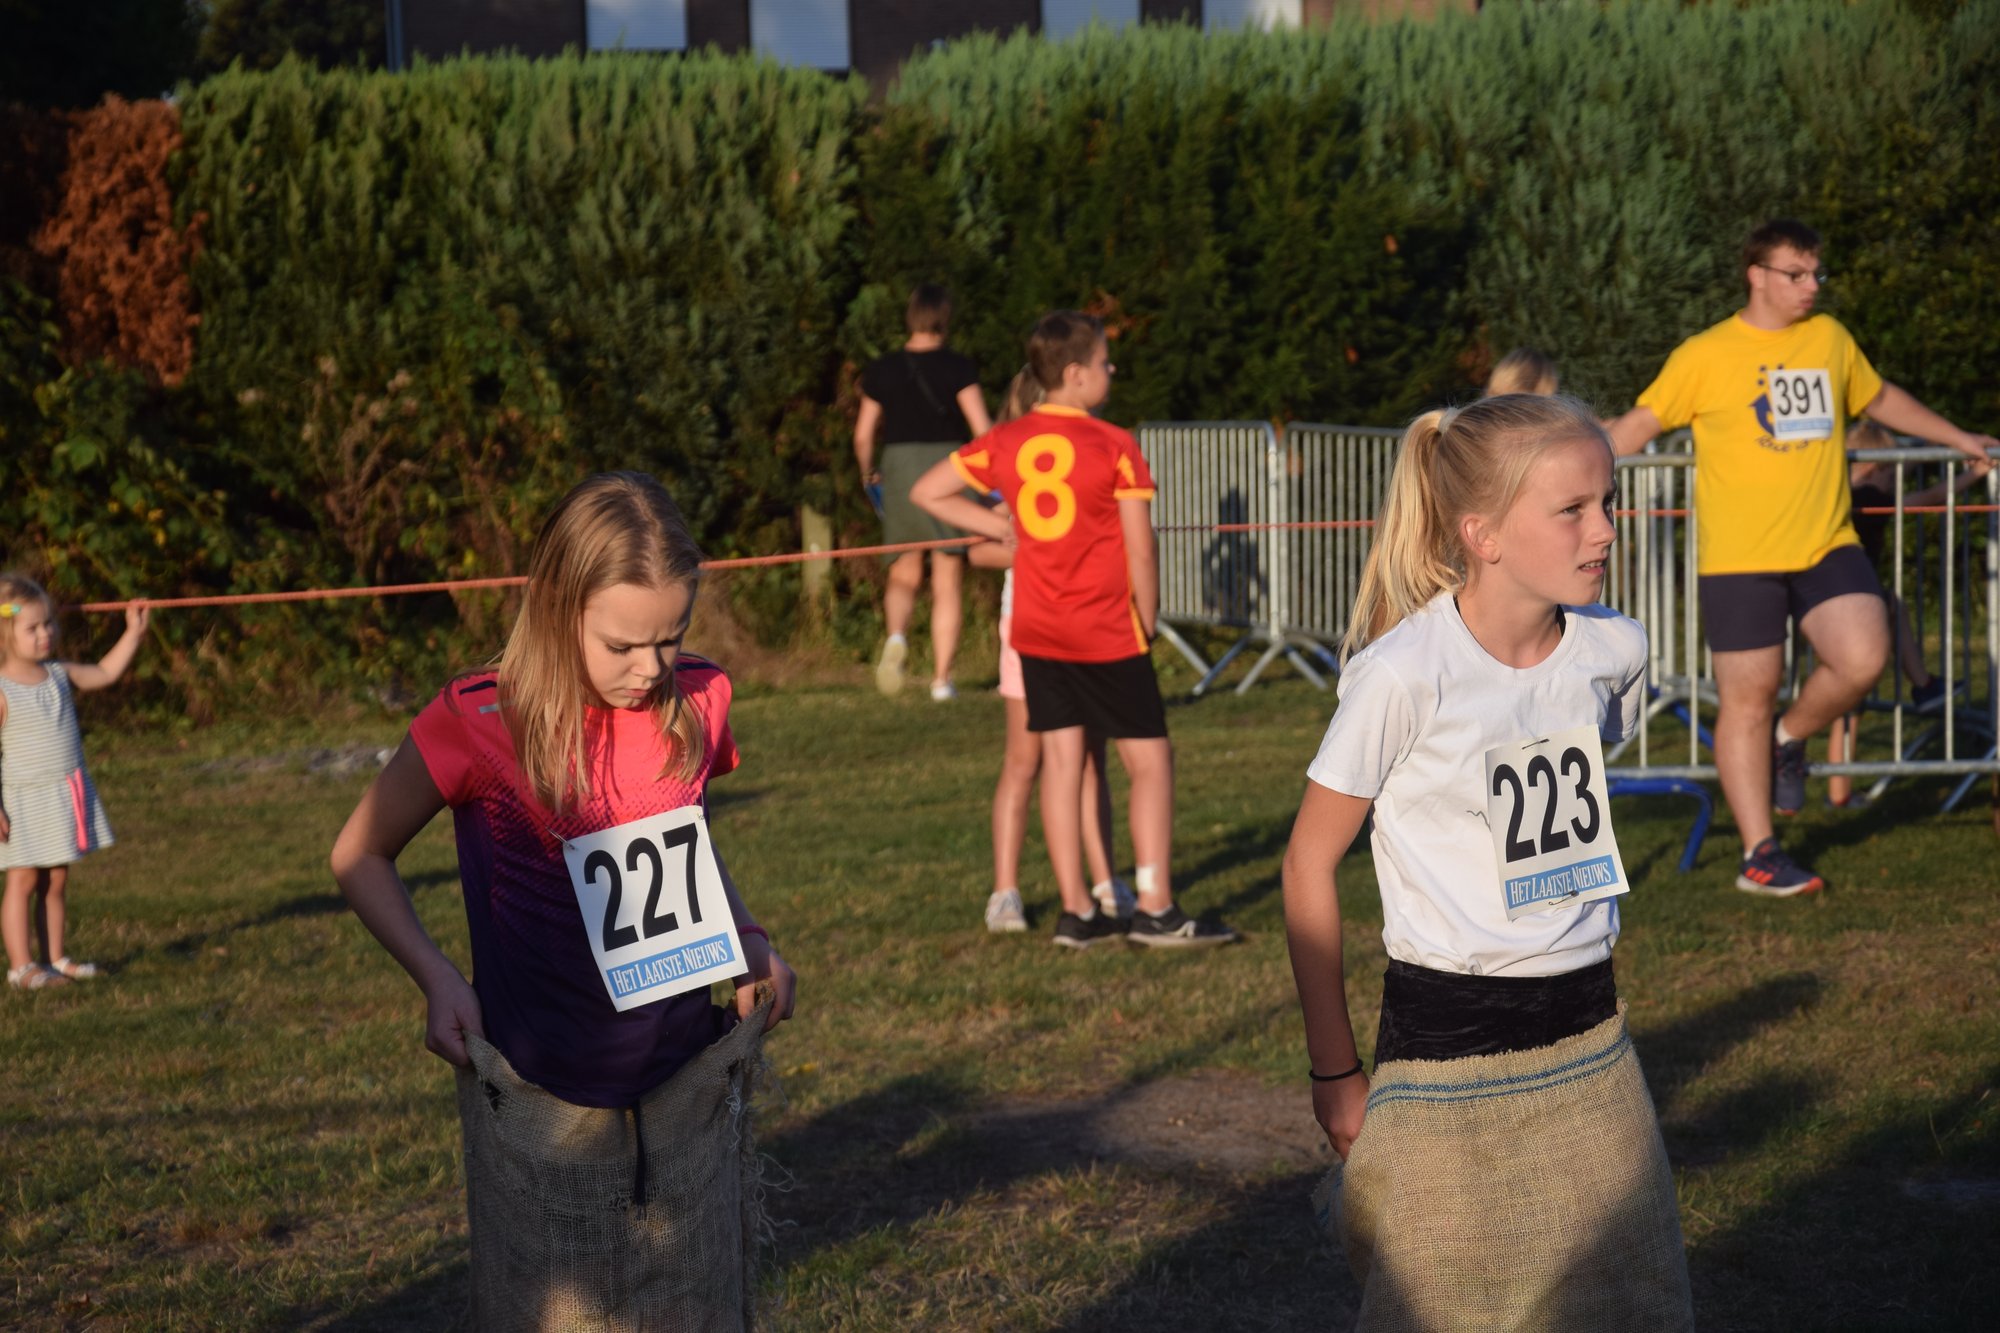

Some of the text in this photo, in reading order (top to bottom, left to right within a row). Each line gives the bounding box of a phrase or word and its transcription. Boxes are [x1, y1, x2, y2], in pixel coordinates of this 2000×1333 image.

[1775, 375, 1826, 415] 391
[1015, 433, 1077, 541] 8
[1493, 747, 1600, 863] 223
[584, 822, 703, 952] 227
[1510, 862, 1612, 905] HET LAATSTE NIEUWS
[612, 940, 728, 994] HET LAATSTE NIEUWS
